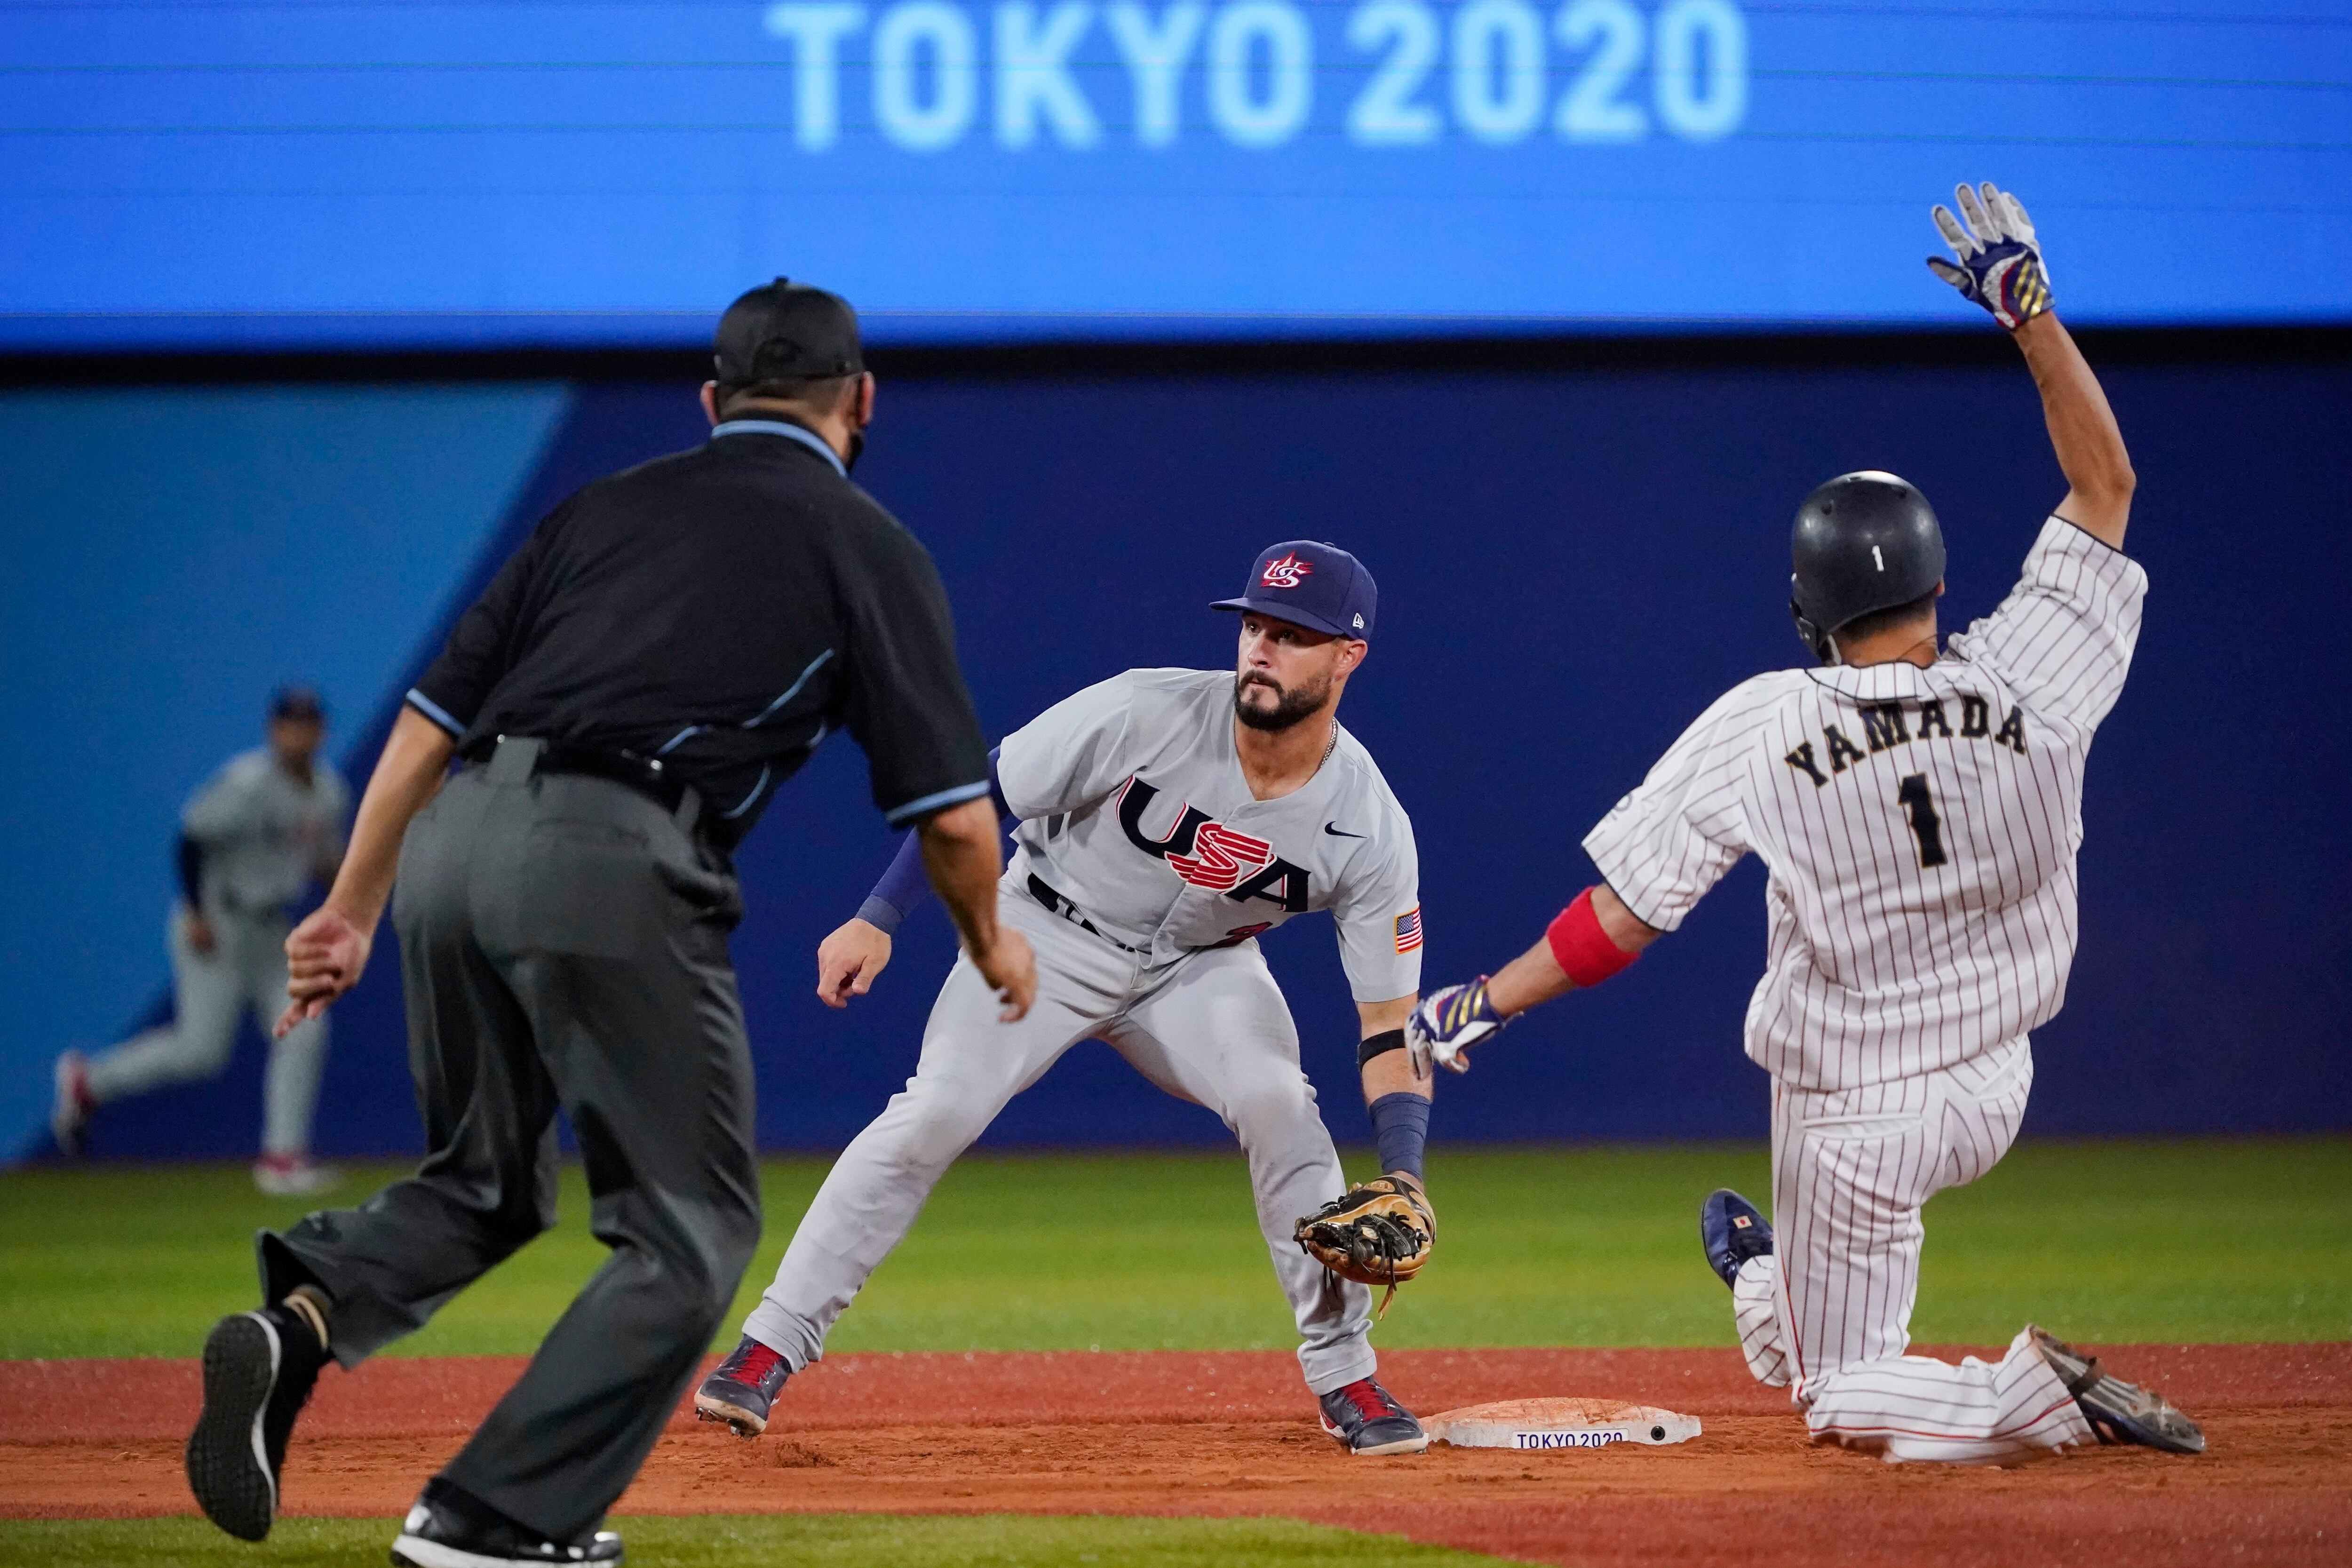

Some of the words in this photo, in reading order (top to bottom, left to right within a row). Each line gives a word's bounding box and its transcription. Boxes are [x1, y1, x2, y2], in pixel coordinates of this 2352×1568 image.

[763, 0, 1315, 151] TOKYO
[1348, 0, 1748, 145] 2020
[1872, 544, 1884, 572] 1
[1784, 694, 2026, 788] YAMADA
[1116, 774, 1311, 913] USA
[1898, 772, 1948, 869] 1
[1517, 1433, 1575, 1449] TOKYO
